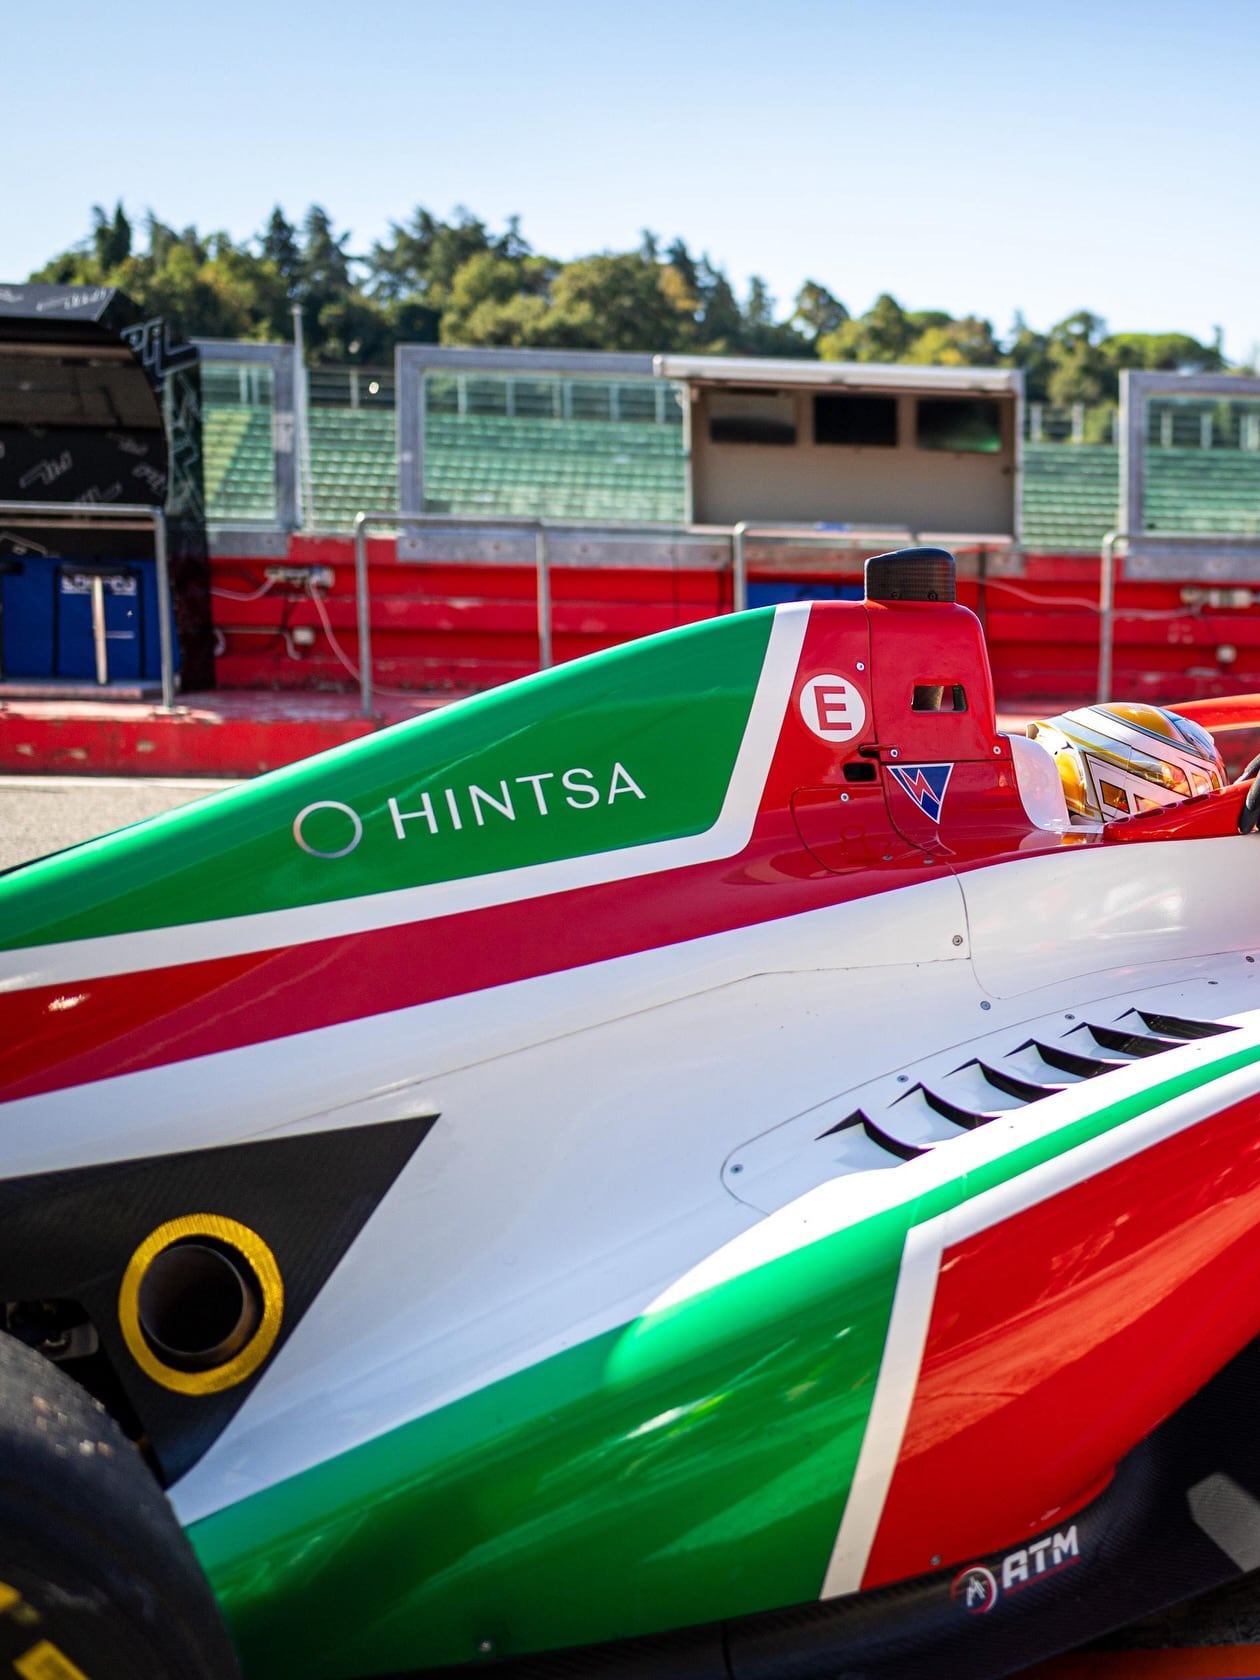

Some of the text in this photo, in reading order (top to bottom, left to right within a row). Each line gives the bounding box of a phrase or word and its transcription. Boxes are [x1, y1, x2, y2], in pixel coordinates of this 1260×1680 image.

[814, 685, 852, 731] E
[388, 762, 647, 839] HINTSA
[1003, 1525, 1079, 1589] ATM
